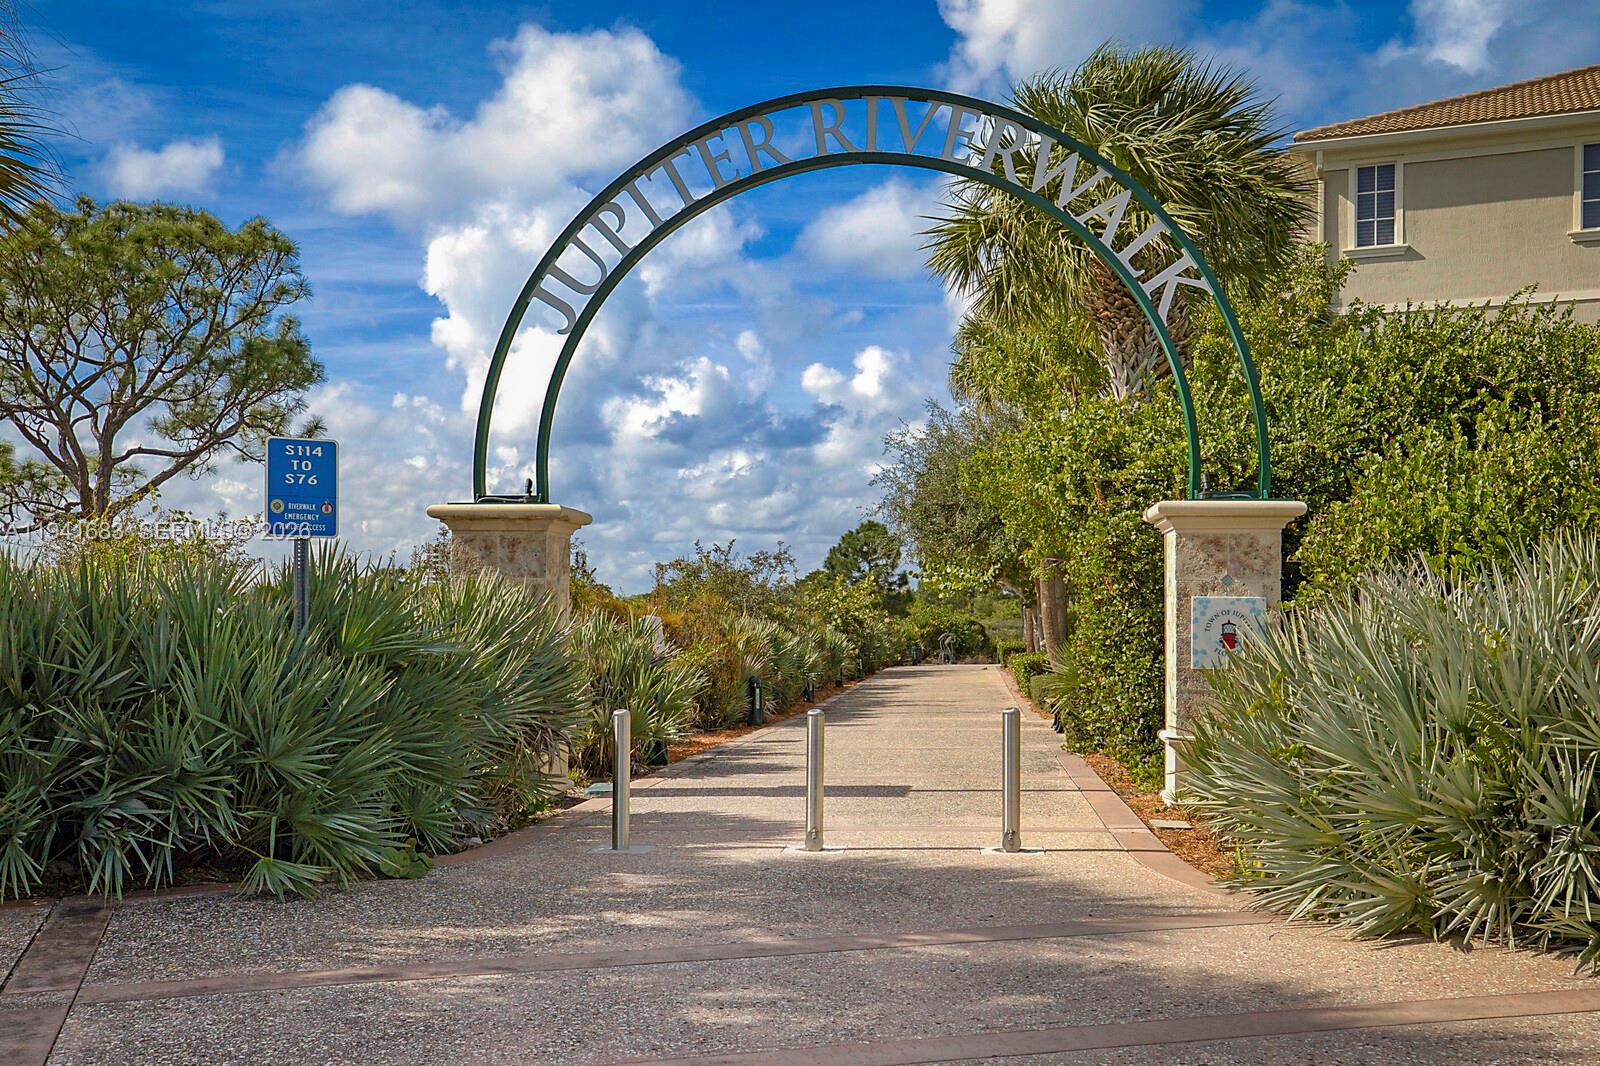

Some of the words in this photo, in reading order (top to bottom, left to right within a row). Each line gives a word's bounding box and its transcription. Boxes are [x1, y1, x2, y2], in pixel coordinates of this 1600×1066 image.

[529, 114, 797, 335] JUPITER
[804, 96, 1214, 324] RIVERWALK
[285, 444, 323, 457] S114
[291, 459, 312, 471] TO
[285, 473, 318, 485] S76
[288, 502, 316, 511] RIVERWALK
[284, 512, 320, 521] EMERGENCY
[1204, 612, 1220, 632] TOWN
